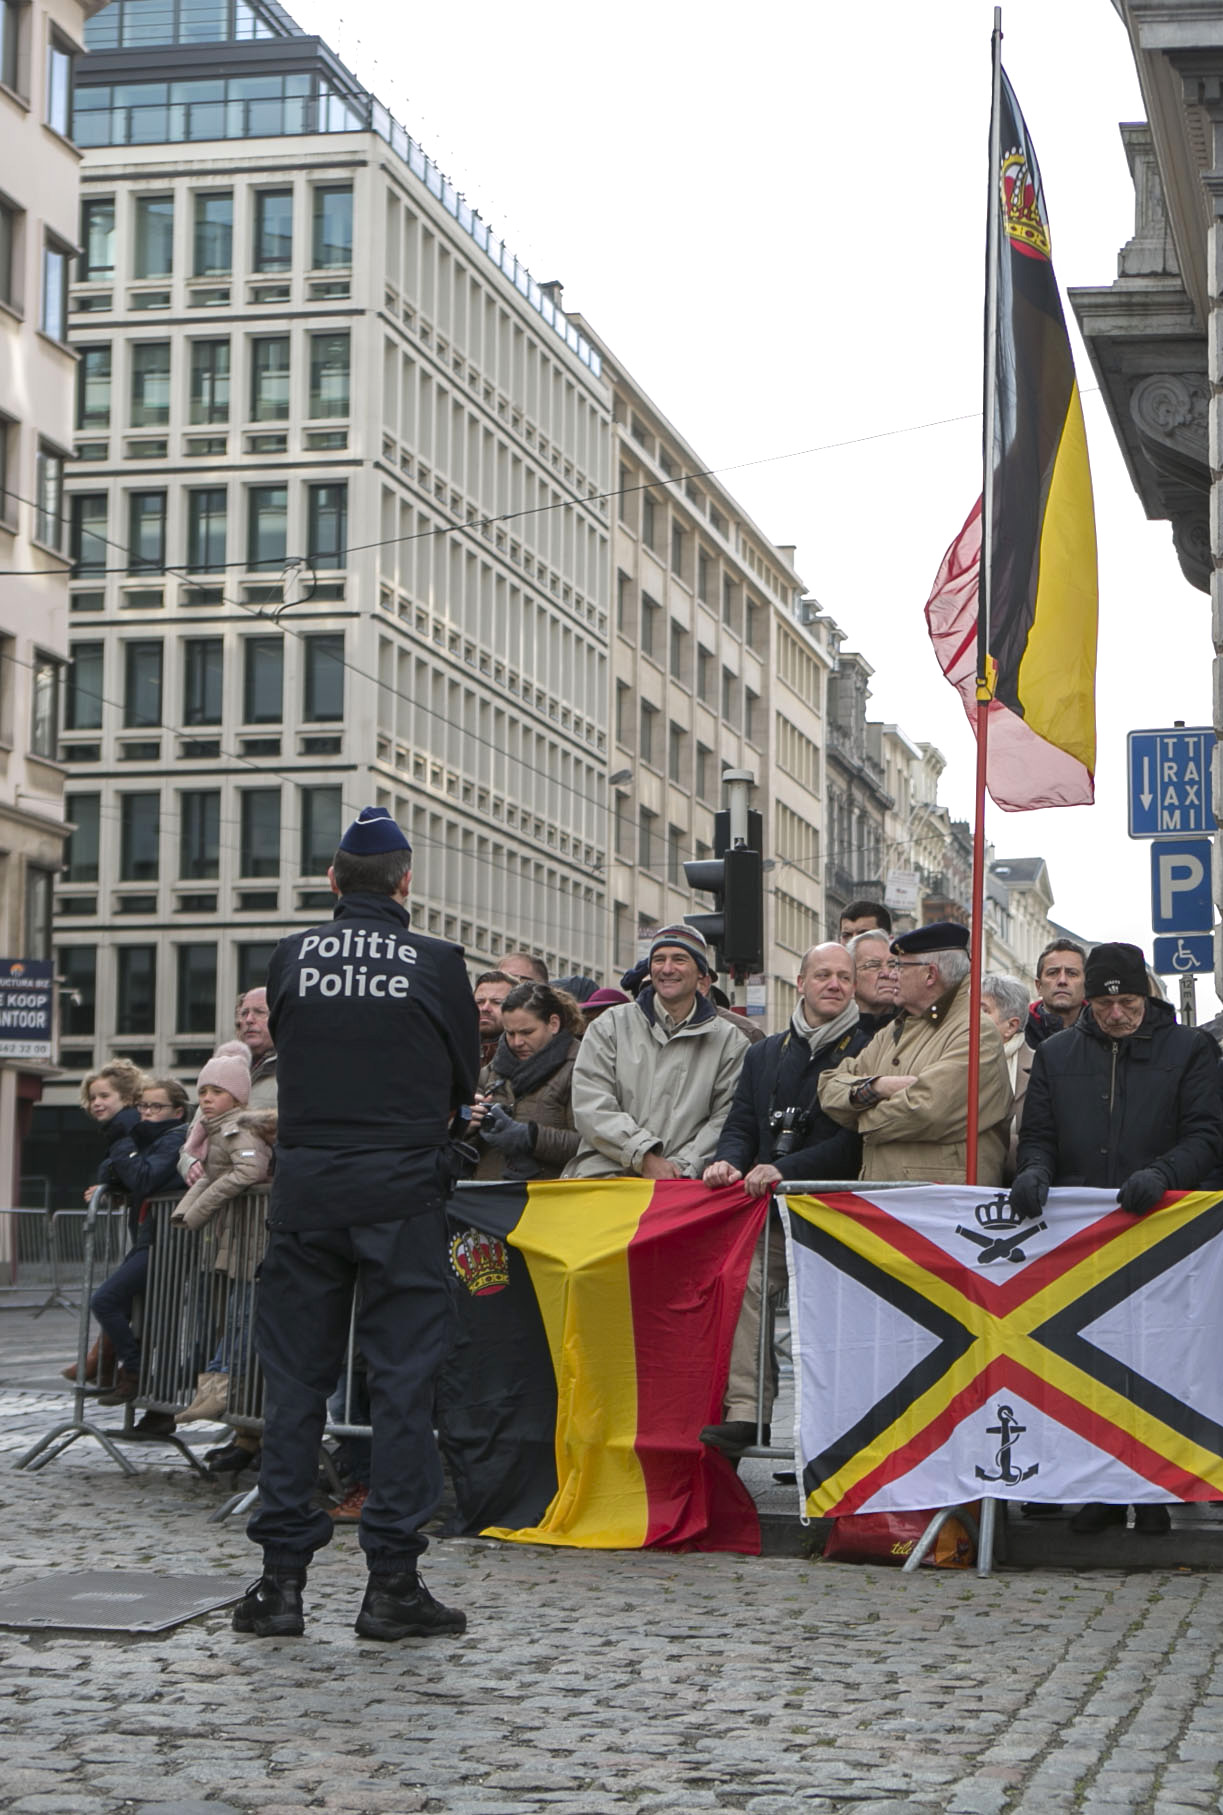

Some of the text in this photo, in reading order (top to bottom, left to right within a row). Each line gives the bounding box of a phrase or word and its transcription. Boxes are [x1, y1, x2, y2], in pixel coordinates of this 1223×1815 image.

[1159, 854, 1204, 919] P
[298, 929, 418, 964] Politie
[0, 978, 34, 987] UCTURA
[299, 965, 410, 998] Police
[1182, 980, 1193, 989] 12
[7, 993, 47, 1008] KOOP
